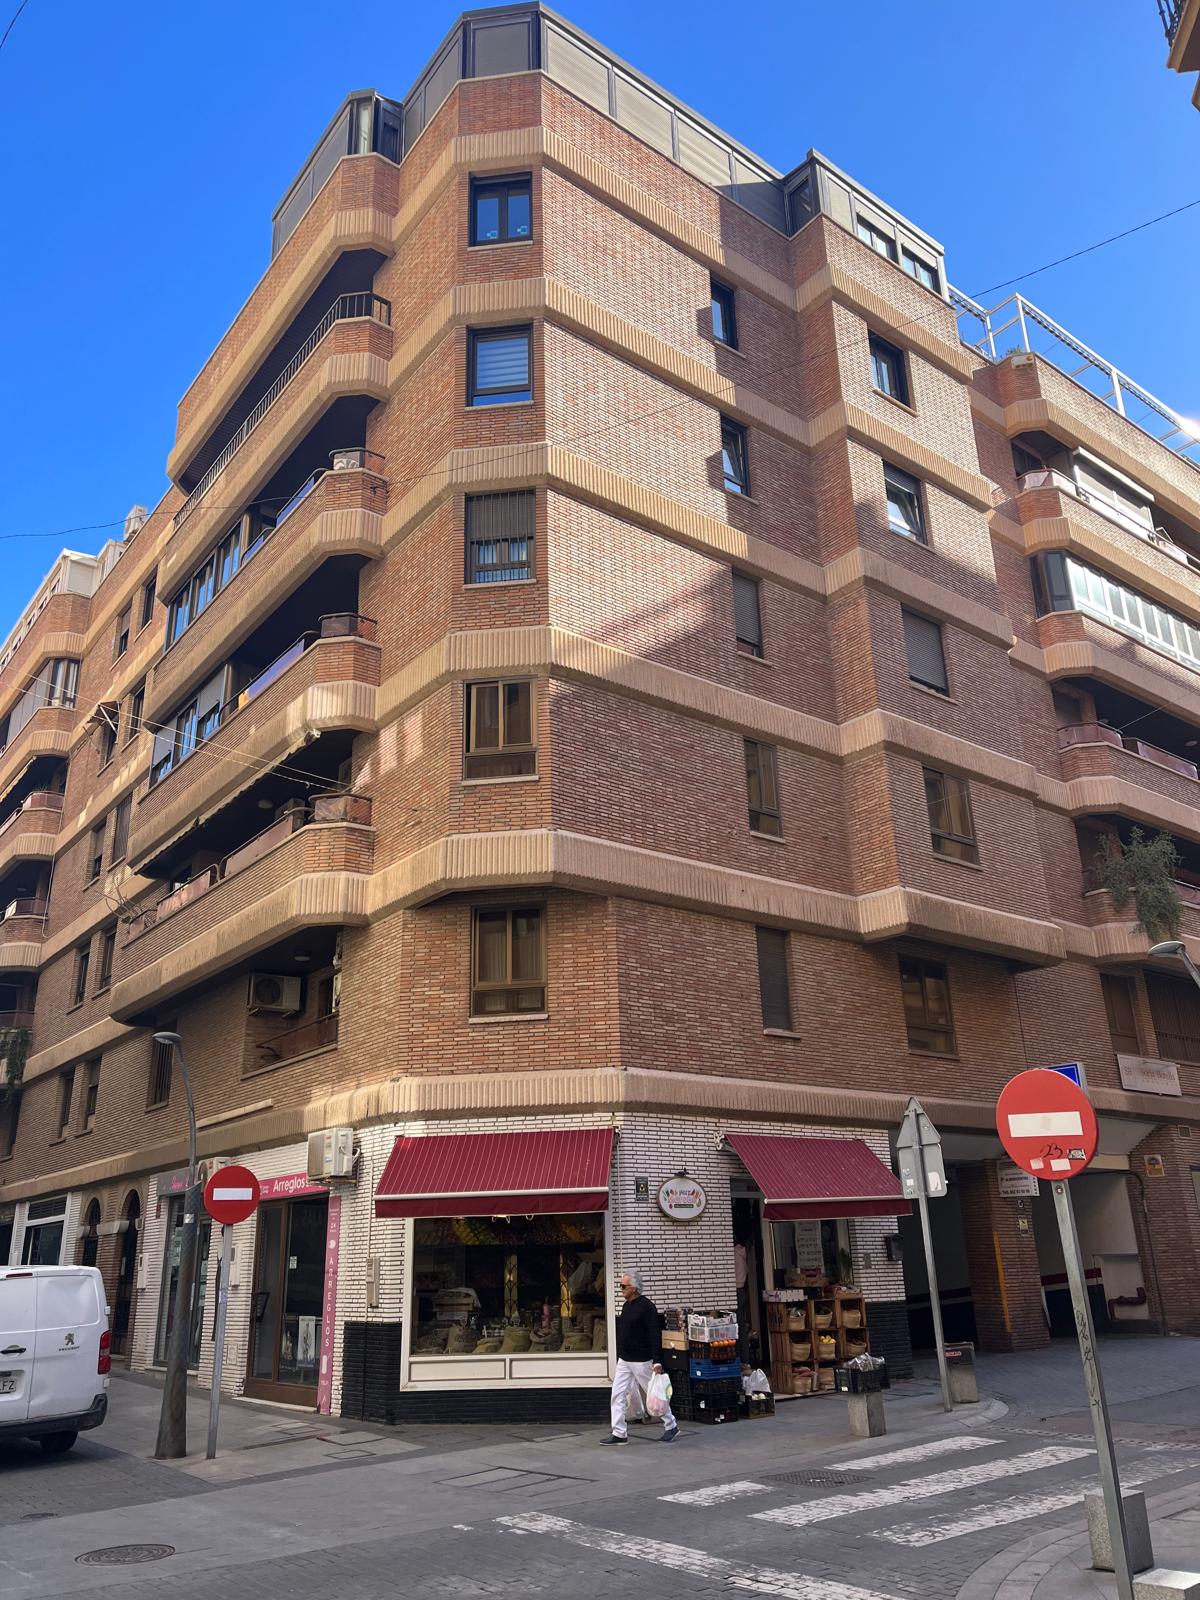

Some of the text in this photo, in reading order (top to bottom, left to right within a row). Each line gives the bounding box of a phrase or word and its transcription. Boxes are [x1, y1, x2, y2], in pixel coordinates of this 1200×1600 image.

[273, 1177, 305, 1194] Arreglos
[325, 1257, 334, 1347] ARREGLOS
[0, 1380, 15, 1391] FZ
